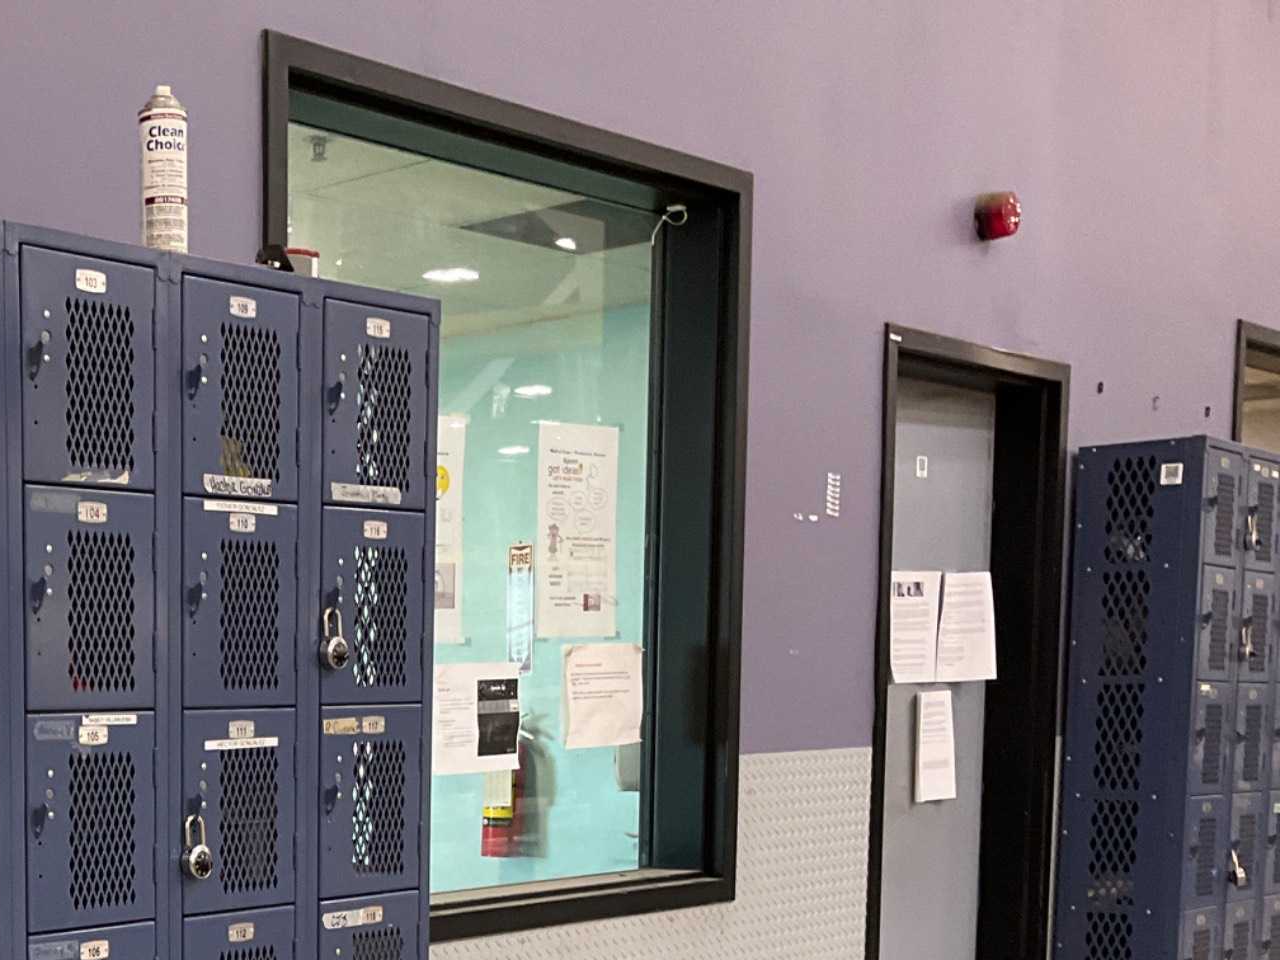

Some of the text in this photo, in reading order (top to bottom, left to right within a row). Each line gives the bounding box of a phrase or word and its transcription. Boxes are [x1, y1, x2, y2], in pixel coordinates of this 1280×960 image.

[149, 125, 183, 138] Clean
[85, 277, 97, 288] 103
[85, 508, 100, 519] 104
[236, 518, 247, 529] 110
[511, 553, 530, 566] FIRE
[87, 731, 99, 741] 105
[236, 727, 246, 737] 111
[236, 928, 246, 939] 112
[88, 947, 100, 957] 106
